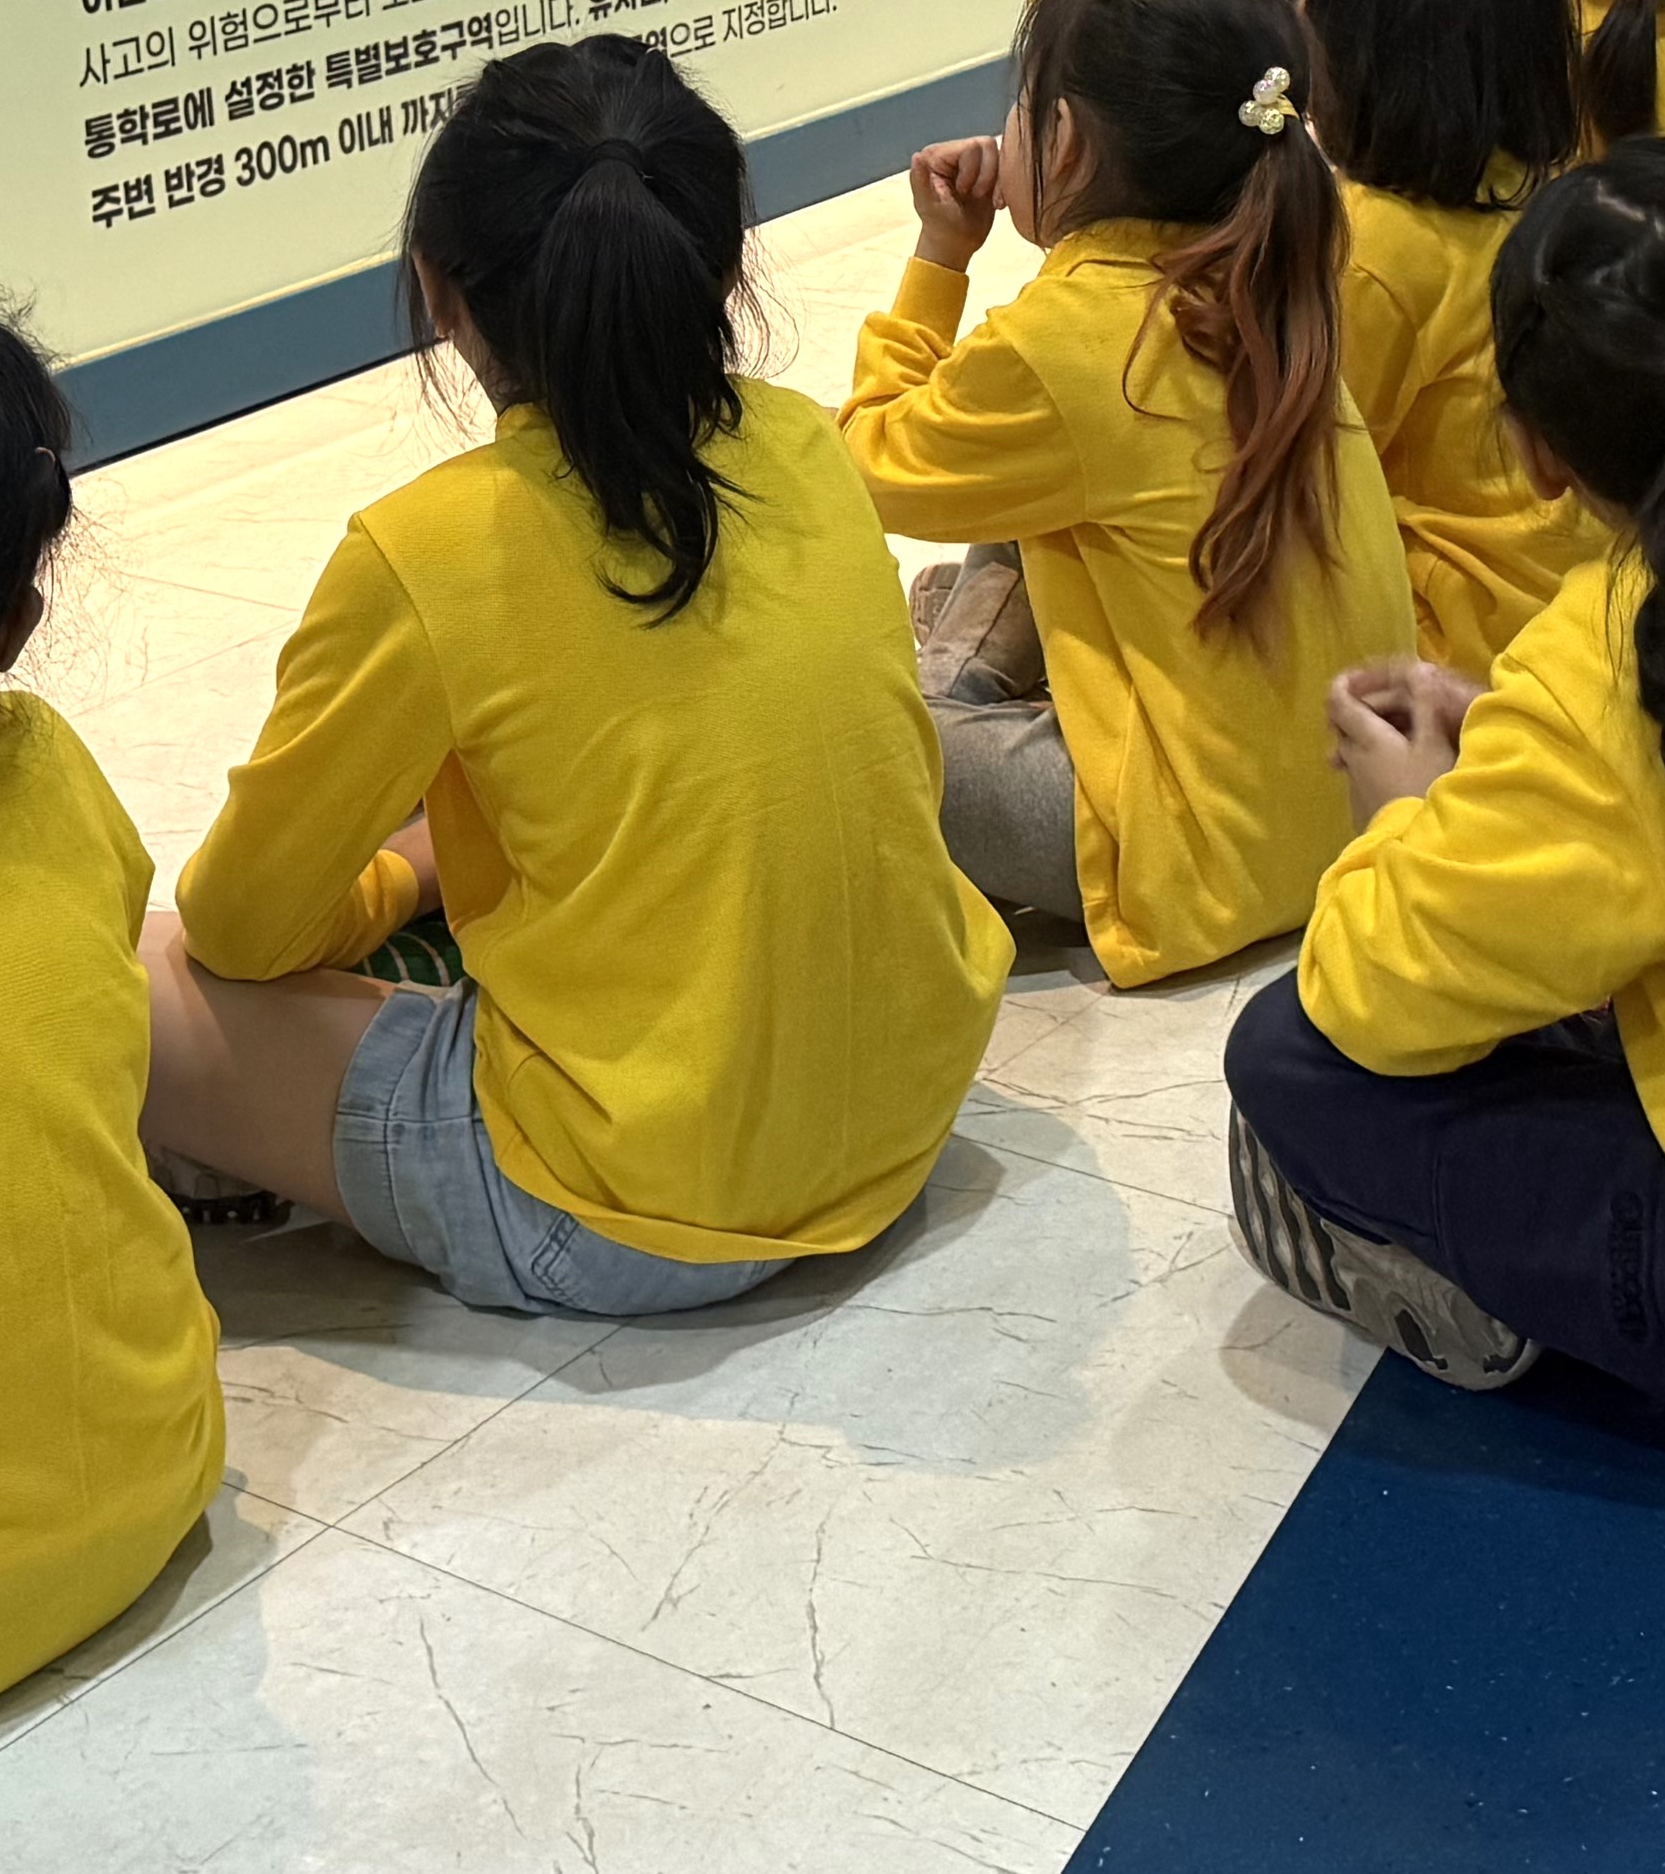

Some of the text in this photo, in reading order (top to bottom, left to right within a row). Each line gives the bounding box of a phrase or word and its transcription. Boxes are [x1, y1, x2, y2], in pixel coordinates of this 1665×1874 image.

[80, 26, 175, 88] 사고의
[84, 87, 214, 159] 통학로에
[225, 60, 315, 120] 설정한
[91, 173, 156, 228] 주변
[164, 154, 226, 208] 반경
[235, 134, 330, 188] 300m
[338, 105, 394, 155] 이내
[635, 15, 716, 58] 역으로
